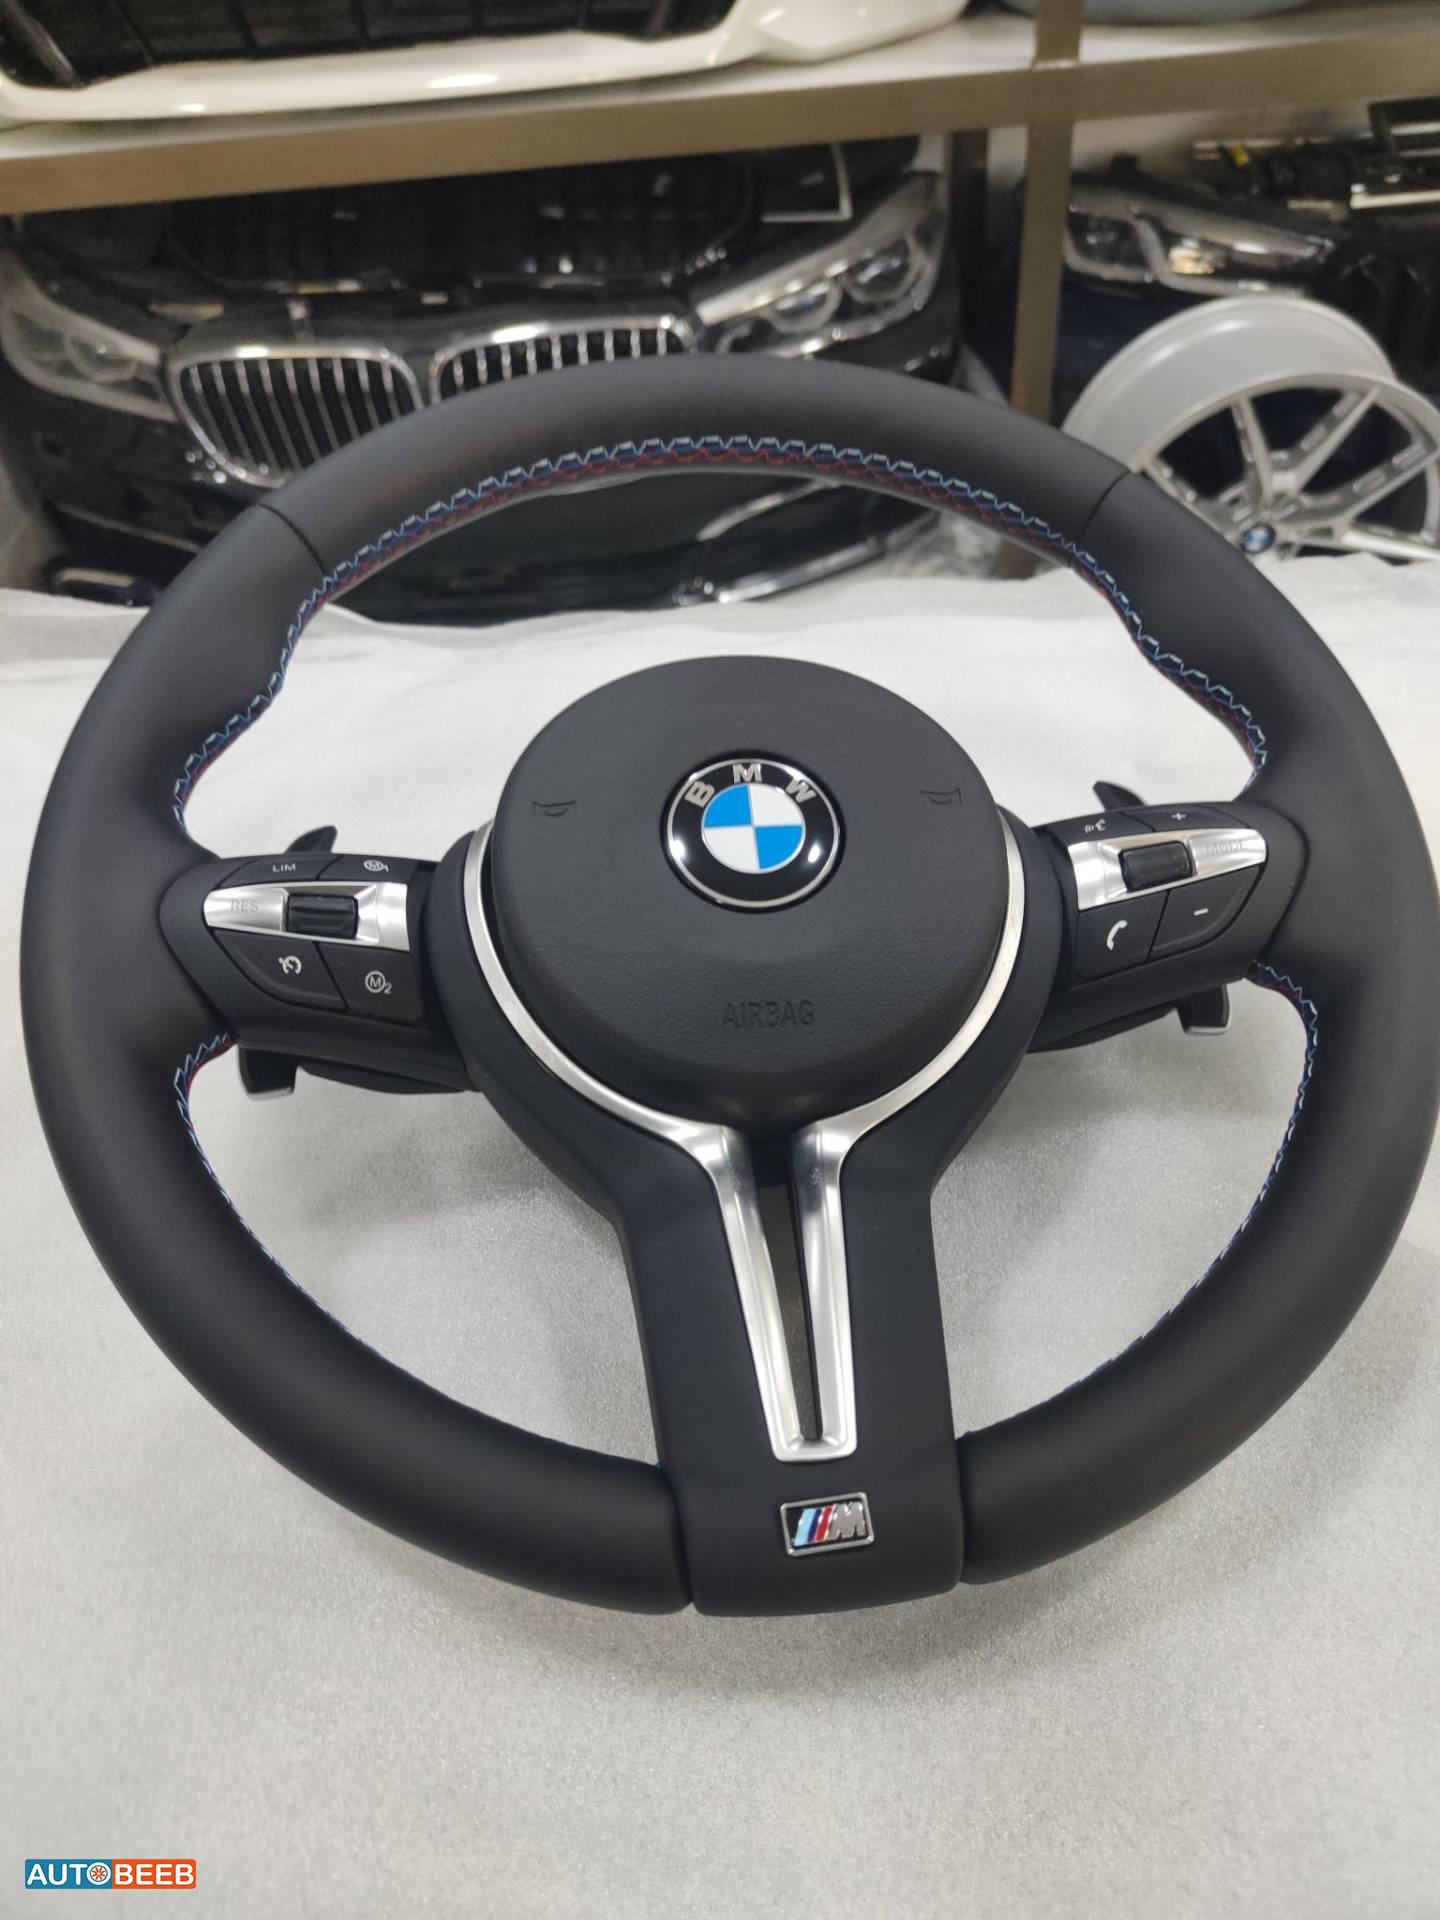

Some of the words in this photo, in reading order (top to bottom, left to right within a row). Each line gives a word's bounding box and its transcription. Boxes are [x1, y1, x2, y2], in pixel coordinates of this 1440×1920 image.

[684, 763, 816, 808] BMW
[272, 863, 296, 872] LIM
[231, 899, 259, 912] RES
[722, 1000, 814, 1029] AIRBAG
